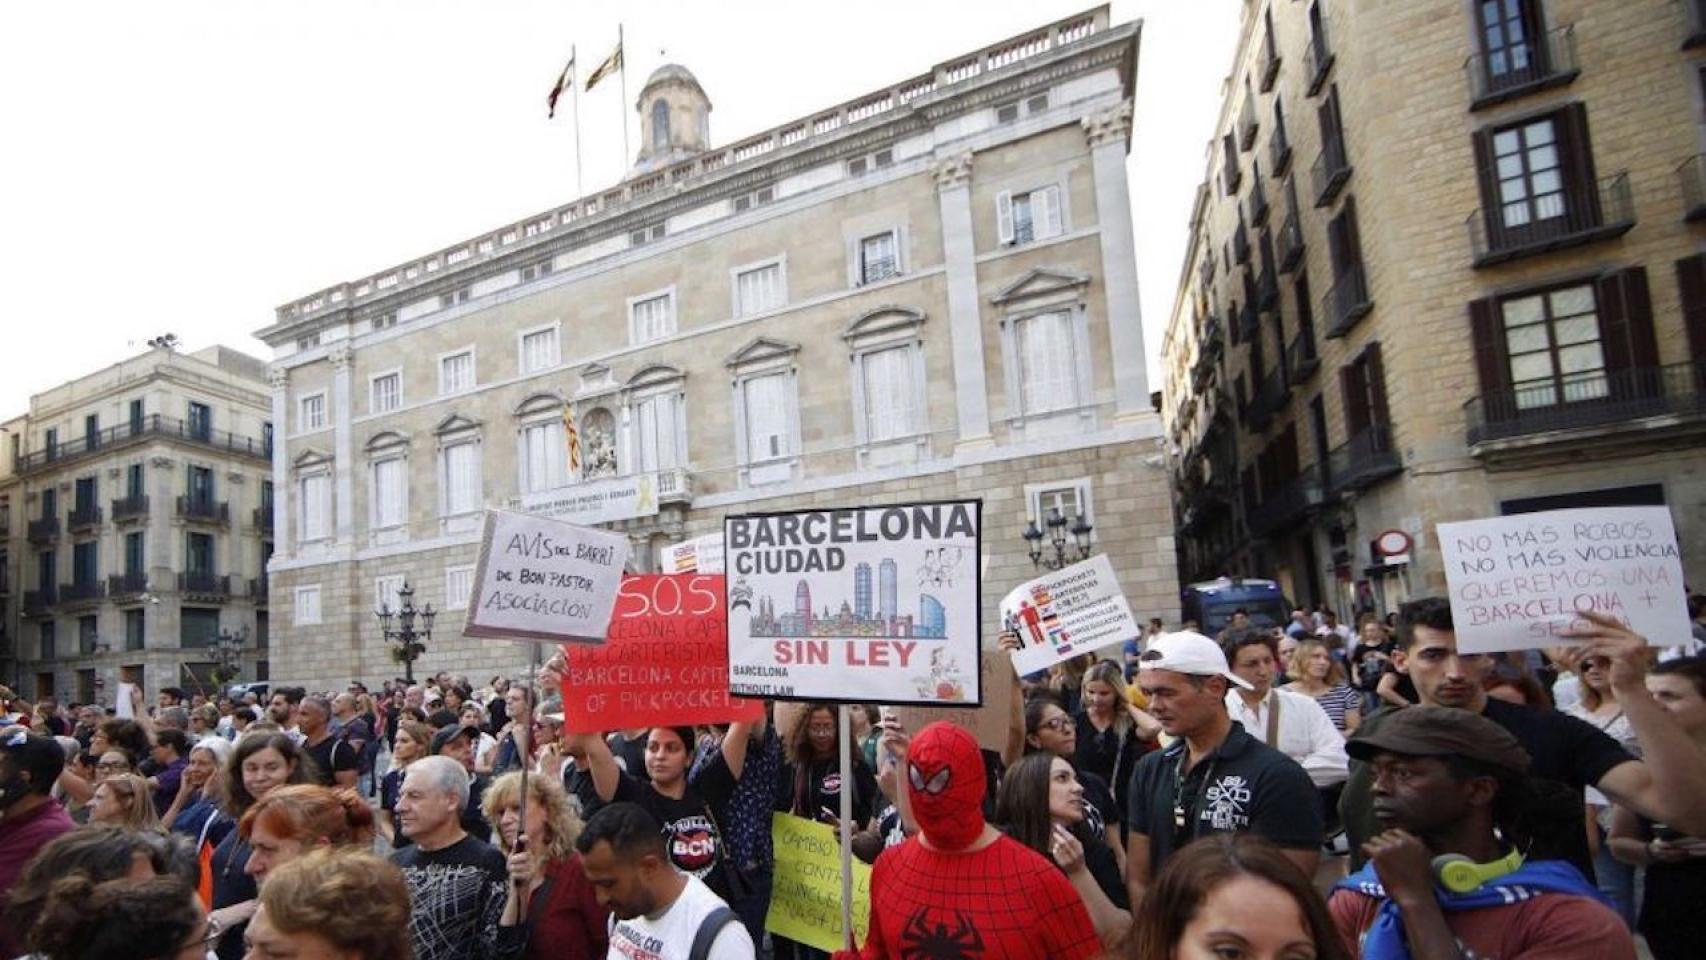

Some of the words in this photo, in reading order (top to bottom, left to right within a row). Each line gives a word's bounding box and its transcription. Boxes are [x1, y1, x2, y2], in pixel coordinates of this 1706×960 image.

[731, 503, 976, 549] BARCELONA
[1457, 534, 1492, 552] NO
[1573, 521, 1652, 542] ROBOS
[736, 547, 845, 575] CIUDAD
[1461, 557, 1496, 575] NO
[1574, 542, 1679, 563] VIOLENCIA
[496, 569, 512, 582] DE
[519, 567, 546, 585] BON
[550, 571, 594, 592] PASTOR
[1460, 568, 1607, 601] QUEREMOS
[1621, 564, 1671, 587] UNA
[1466, 590, 1624, 626] BARCELONA
[1637, 590, 1658, 609] +
[773, 640, 829, 665] SIN
[846, 640, 918, 667] LEY
[571, 666, 673, 687] BARCELONA
[733, 665, 788, 677] BARCELONA
[585, 693, 609, 713] OF
[672, 836, 715, 857] BCN
